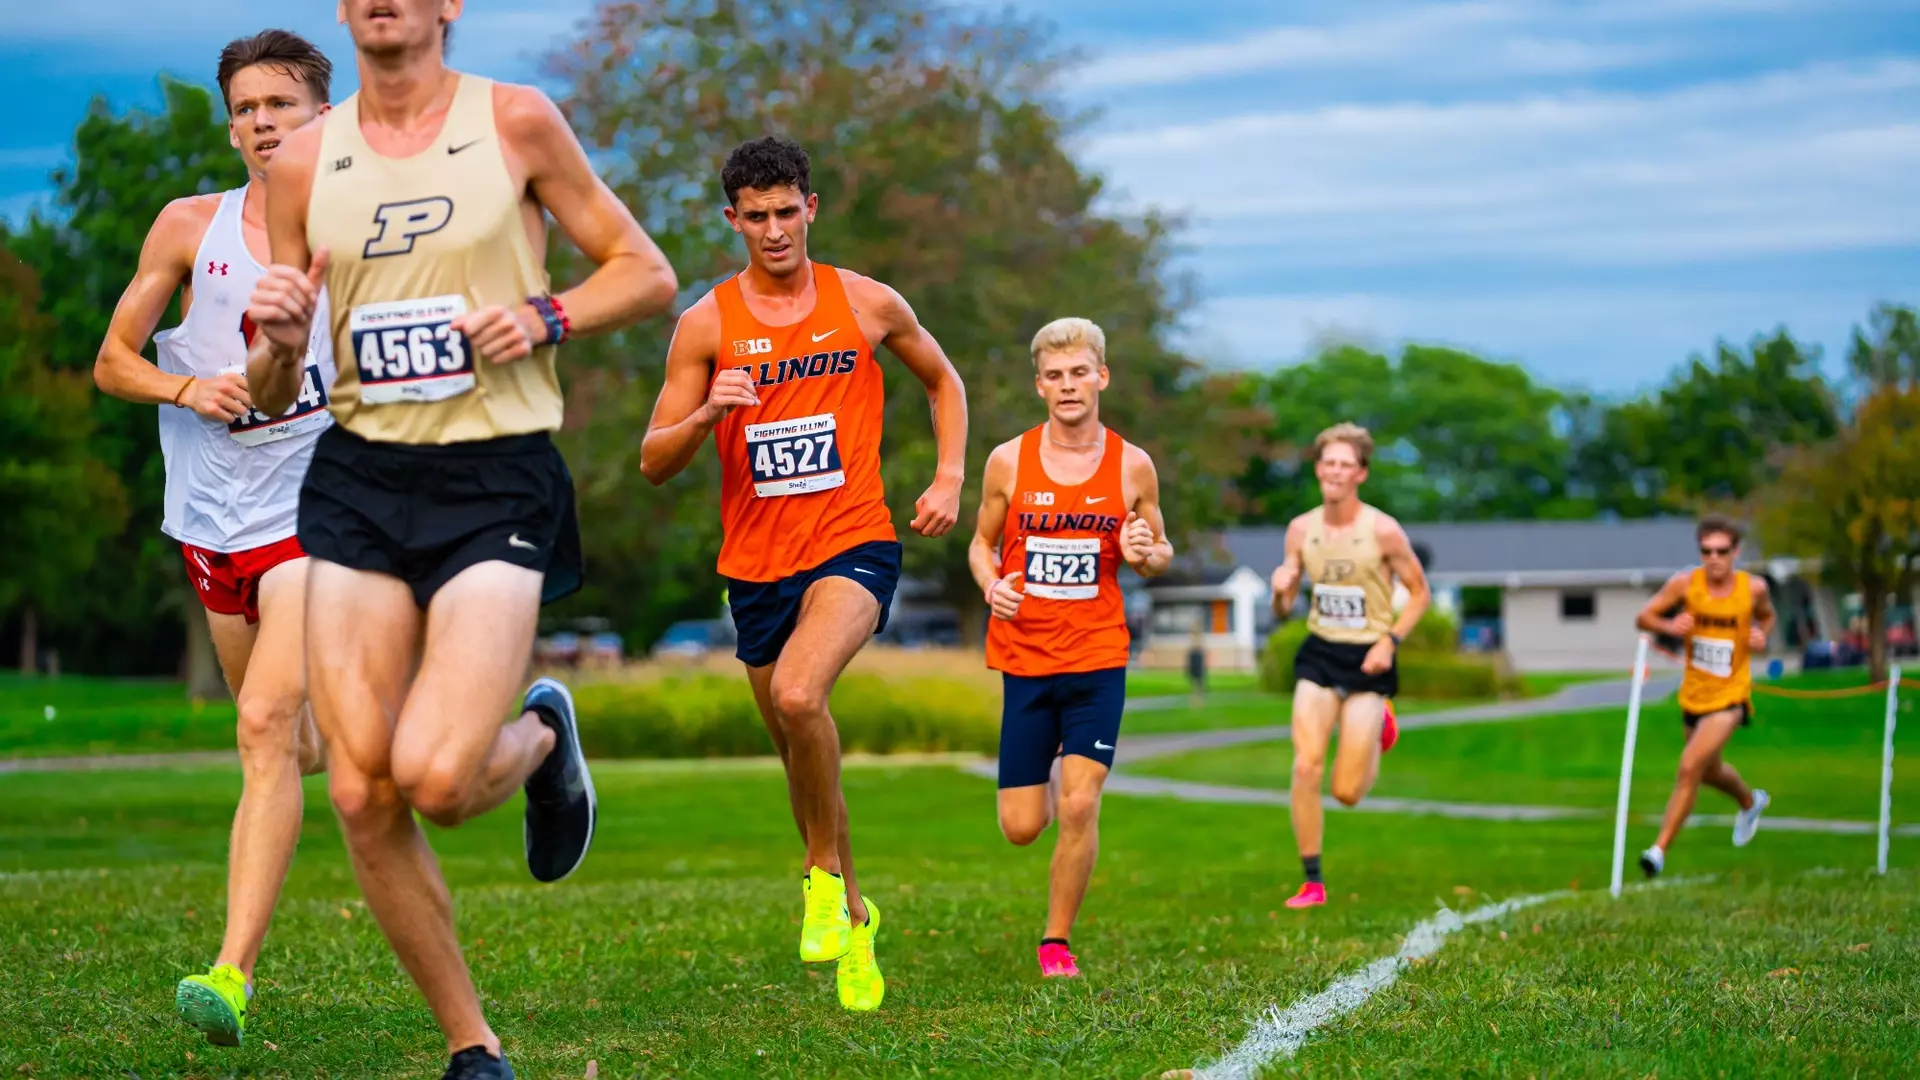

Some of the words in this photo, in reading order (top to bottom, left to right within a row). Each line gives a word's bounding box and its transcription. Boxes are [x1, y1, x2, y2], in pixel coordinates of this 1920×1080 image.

[362, 196, 453, 259] P
[360, 324, 465, 379] 4563
[732, 349, 858, 387] LLINOIS
[754, 426, 798, 438] FIGHTING
[800, 421, 828, 431] ILLINI
[755, 434, 833, 477] 4527
[1018, 512, 1119, 532] ILLINOIS
[1028, 553, 1096, 583] 4523
